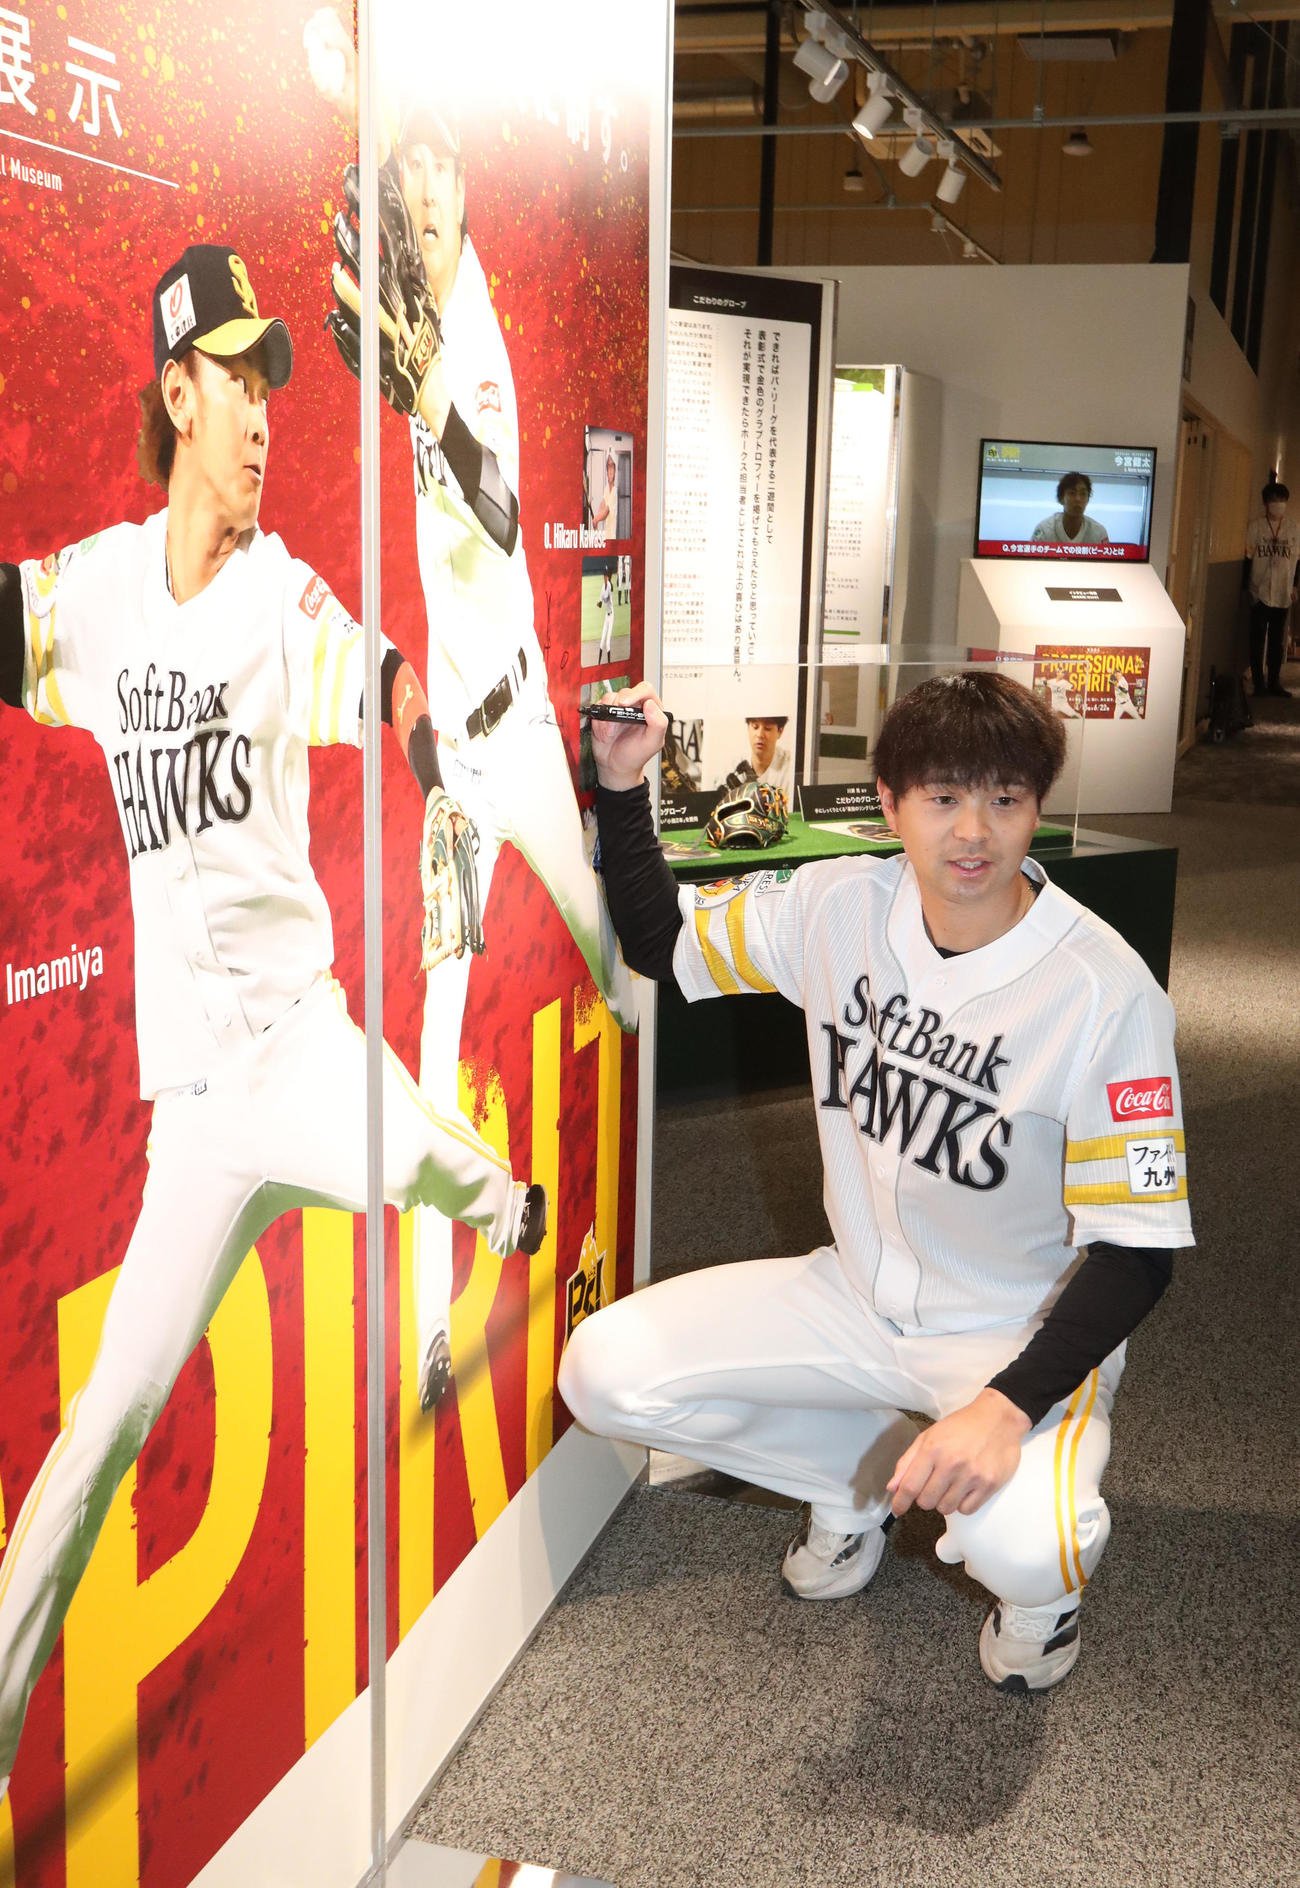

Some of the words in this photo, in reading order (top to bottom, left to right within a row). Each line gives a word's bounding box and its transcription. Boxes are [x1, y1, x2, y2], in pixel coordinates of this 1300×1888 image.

[10, 157, 63, 191] Museum
[554, 523, 578, 549] Hikaru
[579, 523, 607, 549] Kawase
[117, 663, 229, 734] SoftBank
[114, 731, 251, 859] HAWKS
[6, 944, 104, 1005] Imamiya
[844, 975, 1010, 1095] SoftBank
[820, 1022, 1012, 1192] HAWKS
[1143, 1166, 1176, 1187] 九州
